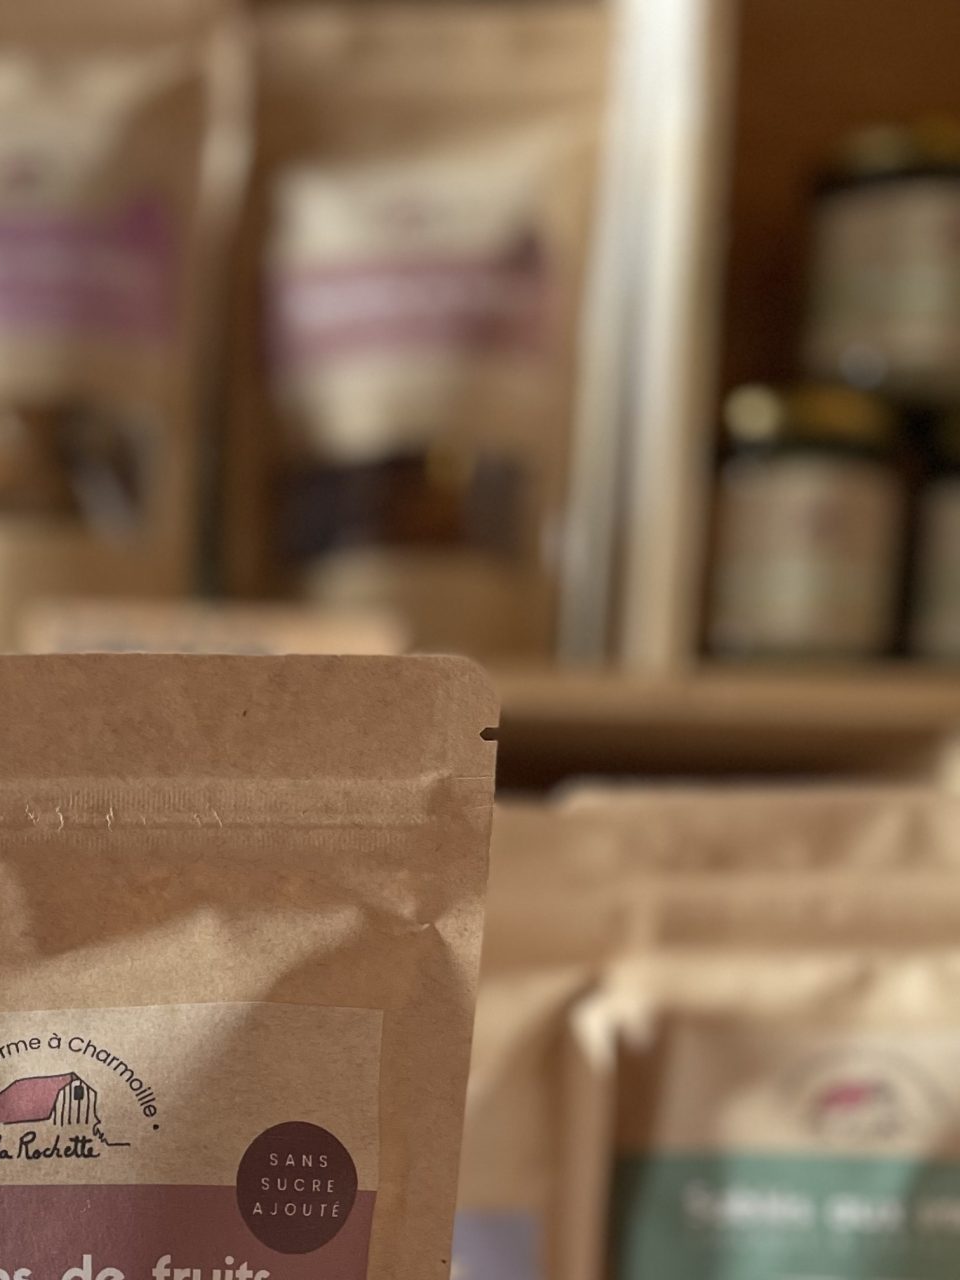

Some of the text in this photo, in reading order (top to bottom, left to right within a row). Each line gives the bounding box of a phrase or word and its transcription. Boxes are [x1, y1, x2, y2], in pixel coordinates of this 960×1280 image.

[47, 1032, 62, 1050] à
[68, 1036, 158, 1118] Charmoille
[16, 1131, 101, 1160] Rochette
[269, 1152, 328, 1168] SANS
[261, 1177, 335, 1193] SUCRE
[252, 1201, 340, 1218] AJOUTÉ
